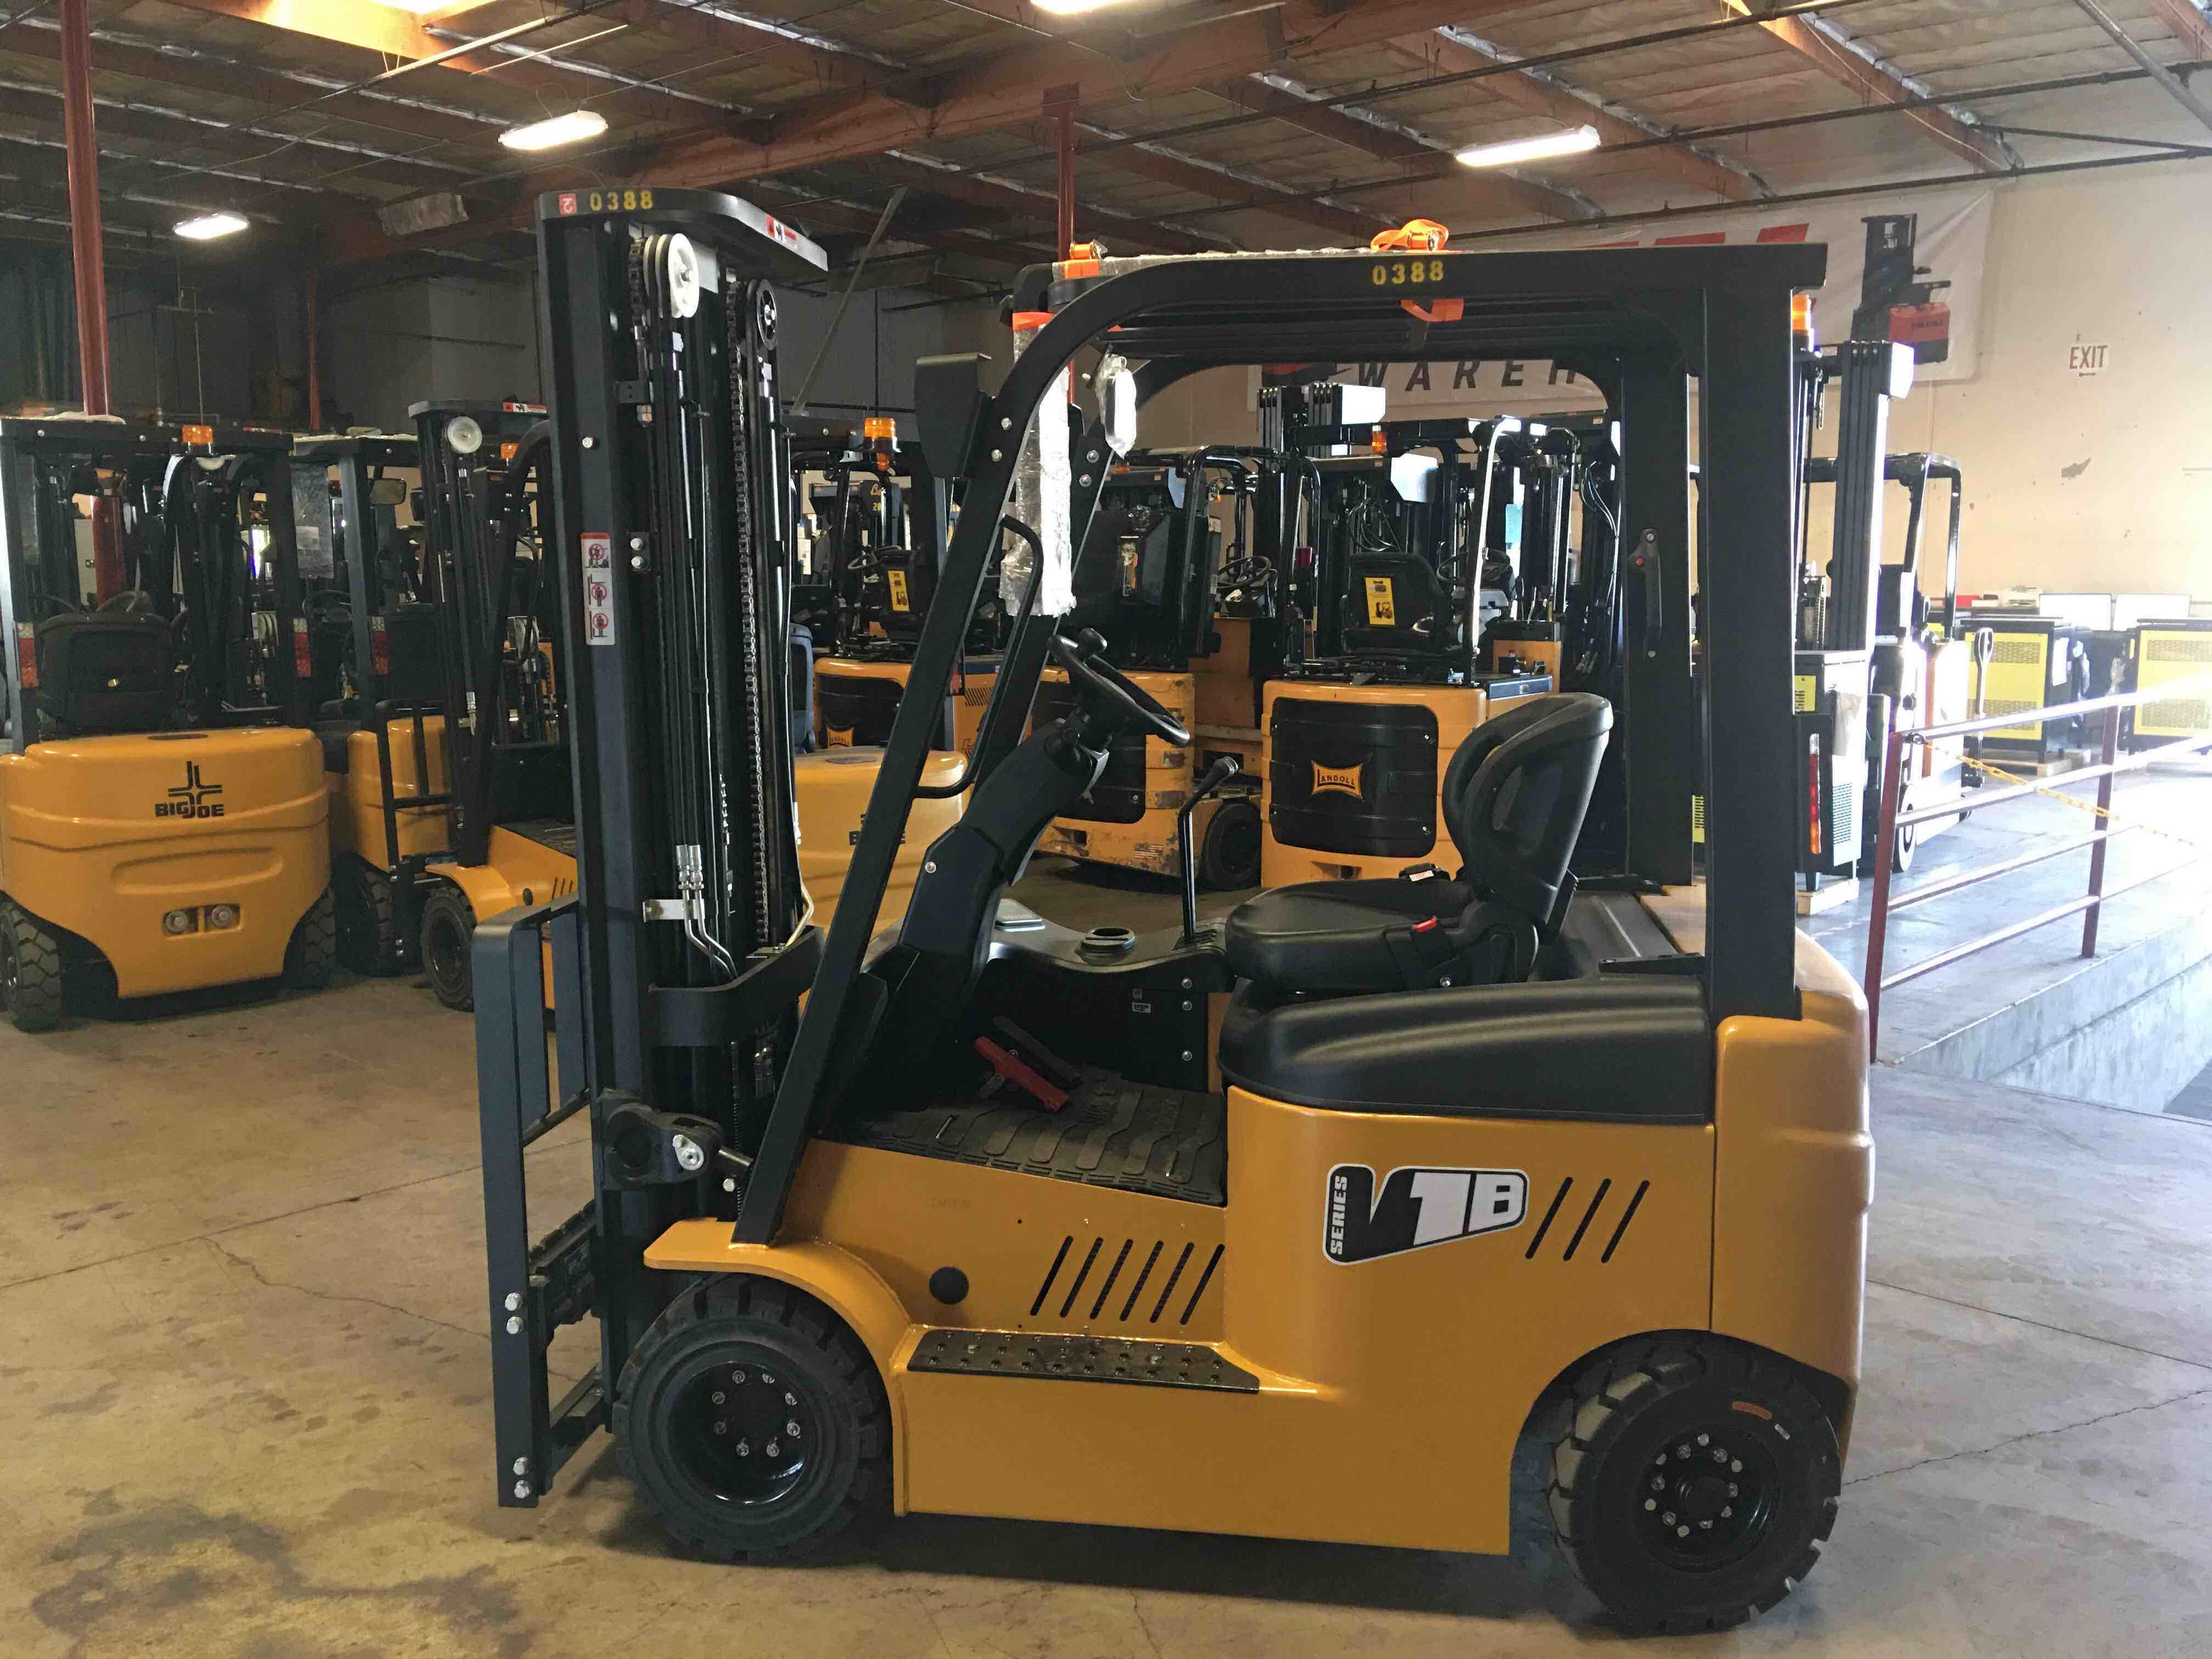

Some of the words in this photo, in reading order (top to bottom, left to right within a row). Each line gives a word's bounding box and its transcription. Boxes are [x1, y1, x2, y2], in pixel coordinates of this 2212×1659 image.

[590, 191, 653, 211] 0388
[1372, 260, 1444, 285] 0388
[2070, 345, 2108, 369] EXIT
[1317, 768, 1356, 790] LANDOLL
[1330, 1175, 1347, 1255] SERIES
